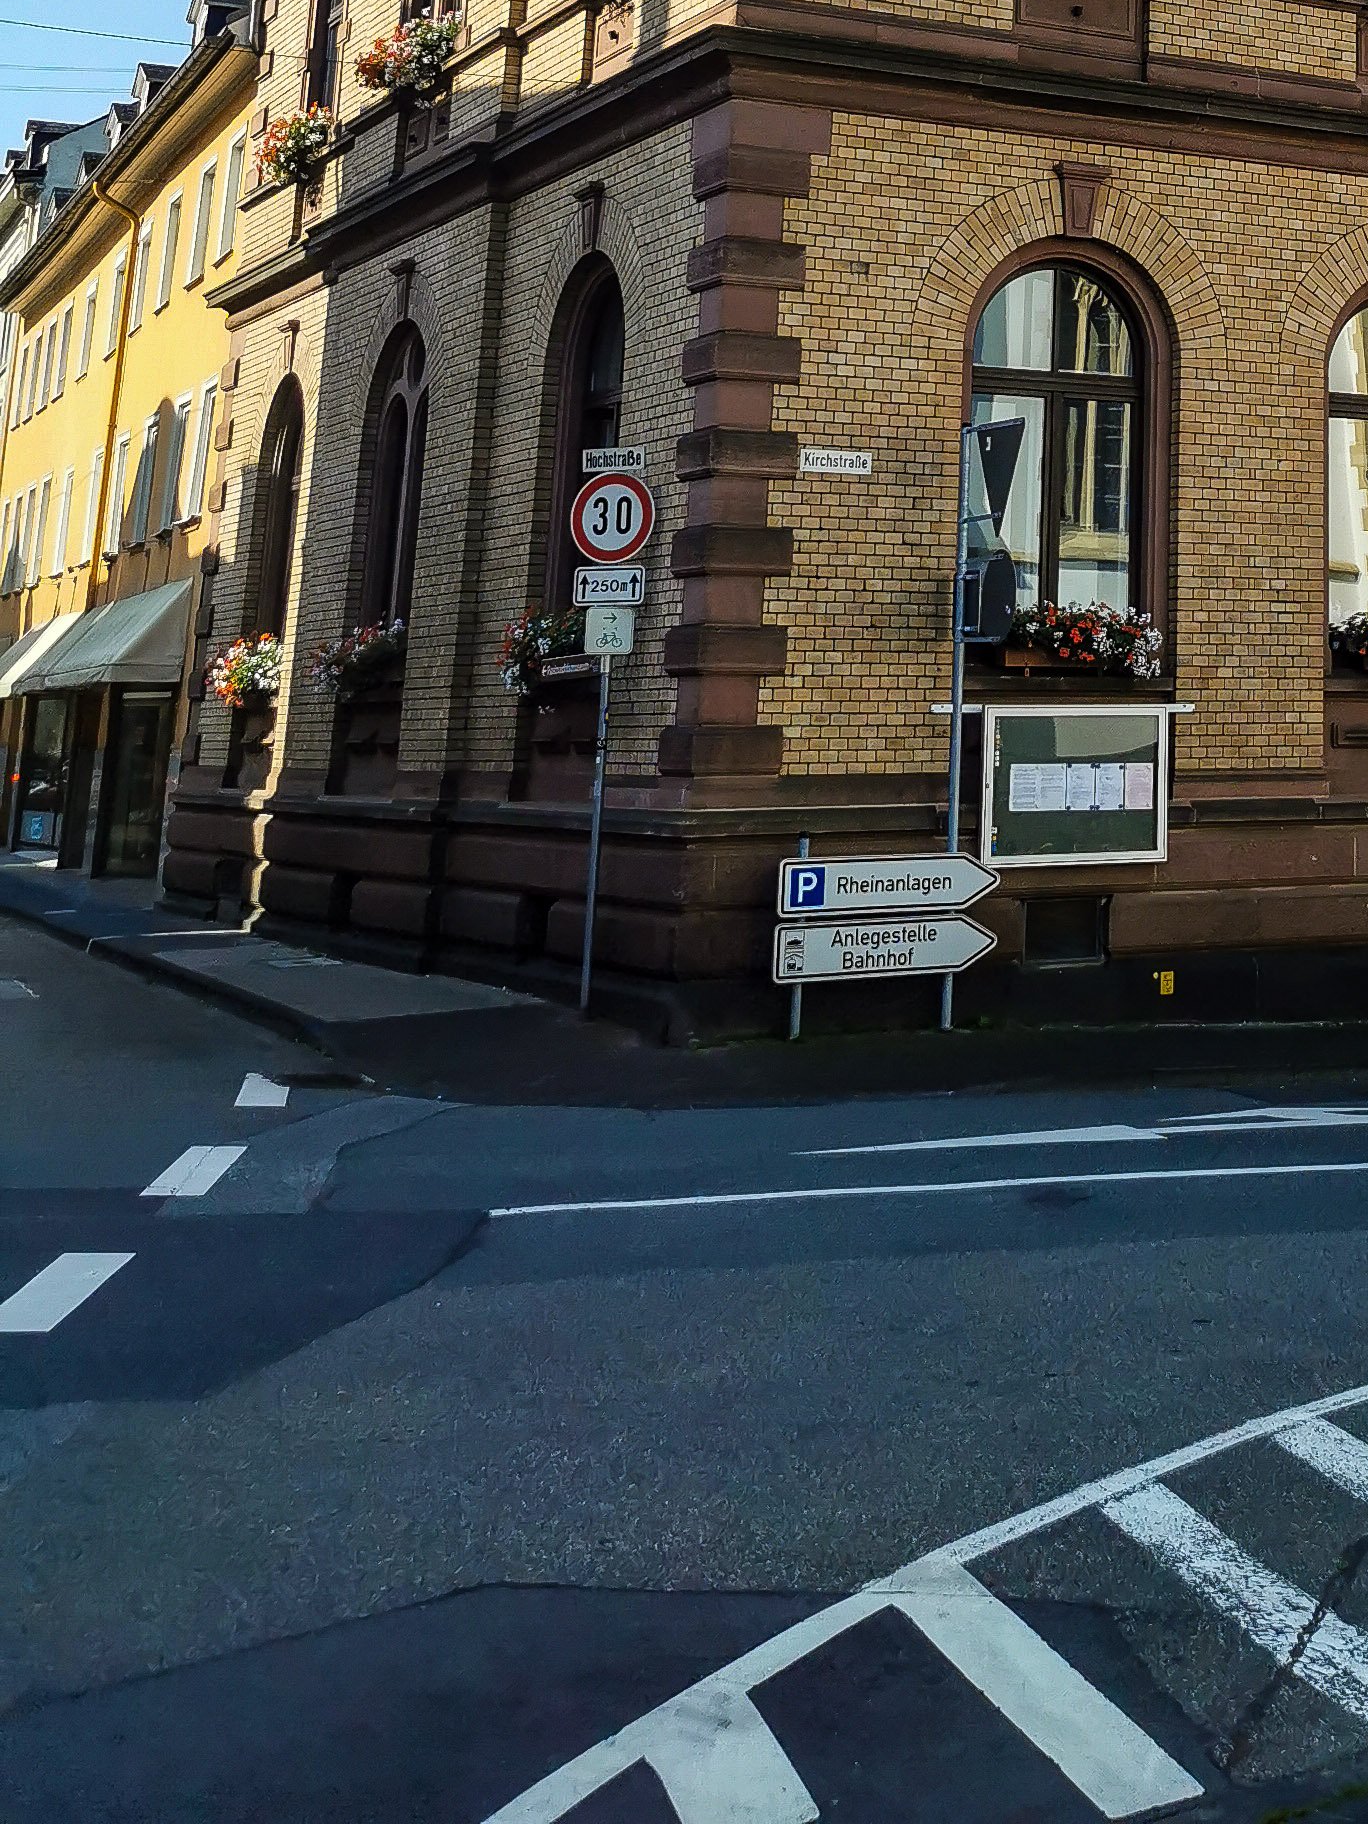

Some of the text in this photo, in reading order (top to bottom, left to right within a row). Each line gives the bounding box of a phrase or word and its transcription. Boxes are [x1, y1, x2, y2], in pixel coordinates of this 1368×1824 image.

[585, 449, 642, 469] Hochstraße
[803, 450, 869, 470] Kirchstraße
[592, 495, 633, 536] 30
[797, 871, 952, 904] P Rheinanlagen
[831, 924, 938, 950] Anlegestelle
[842, 947, 915, 970] Bahnhof
